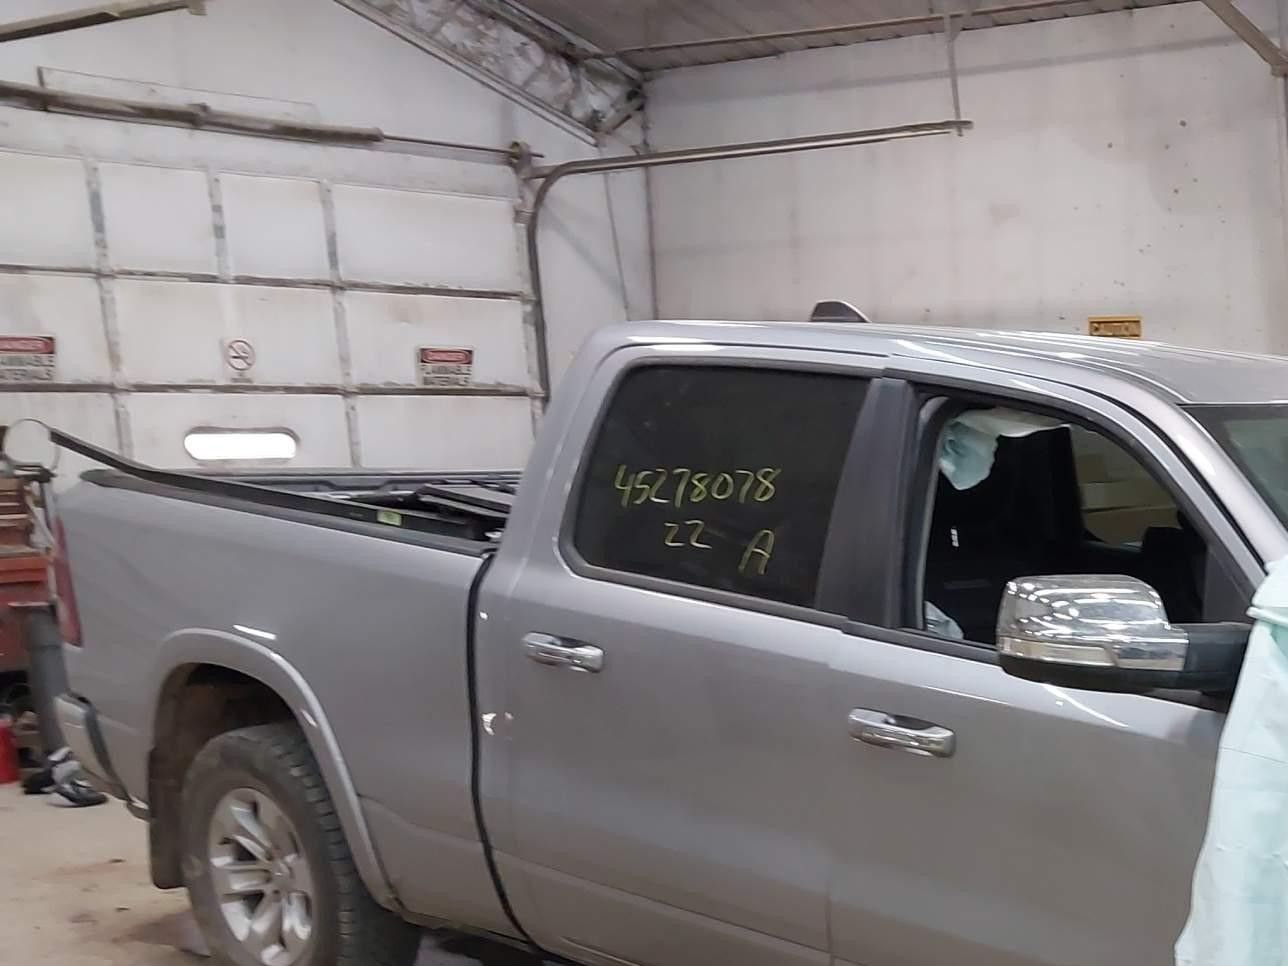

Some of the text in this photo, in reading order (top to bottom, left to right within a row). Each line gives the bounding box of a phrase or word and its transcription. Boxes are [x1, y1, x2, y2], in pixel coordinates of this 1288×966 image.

[614, 464, 782, 508] 45278078
[663, 519, 775, 576] 22 A
